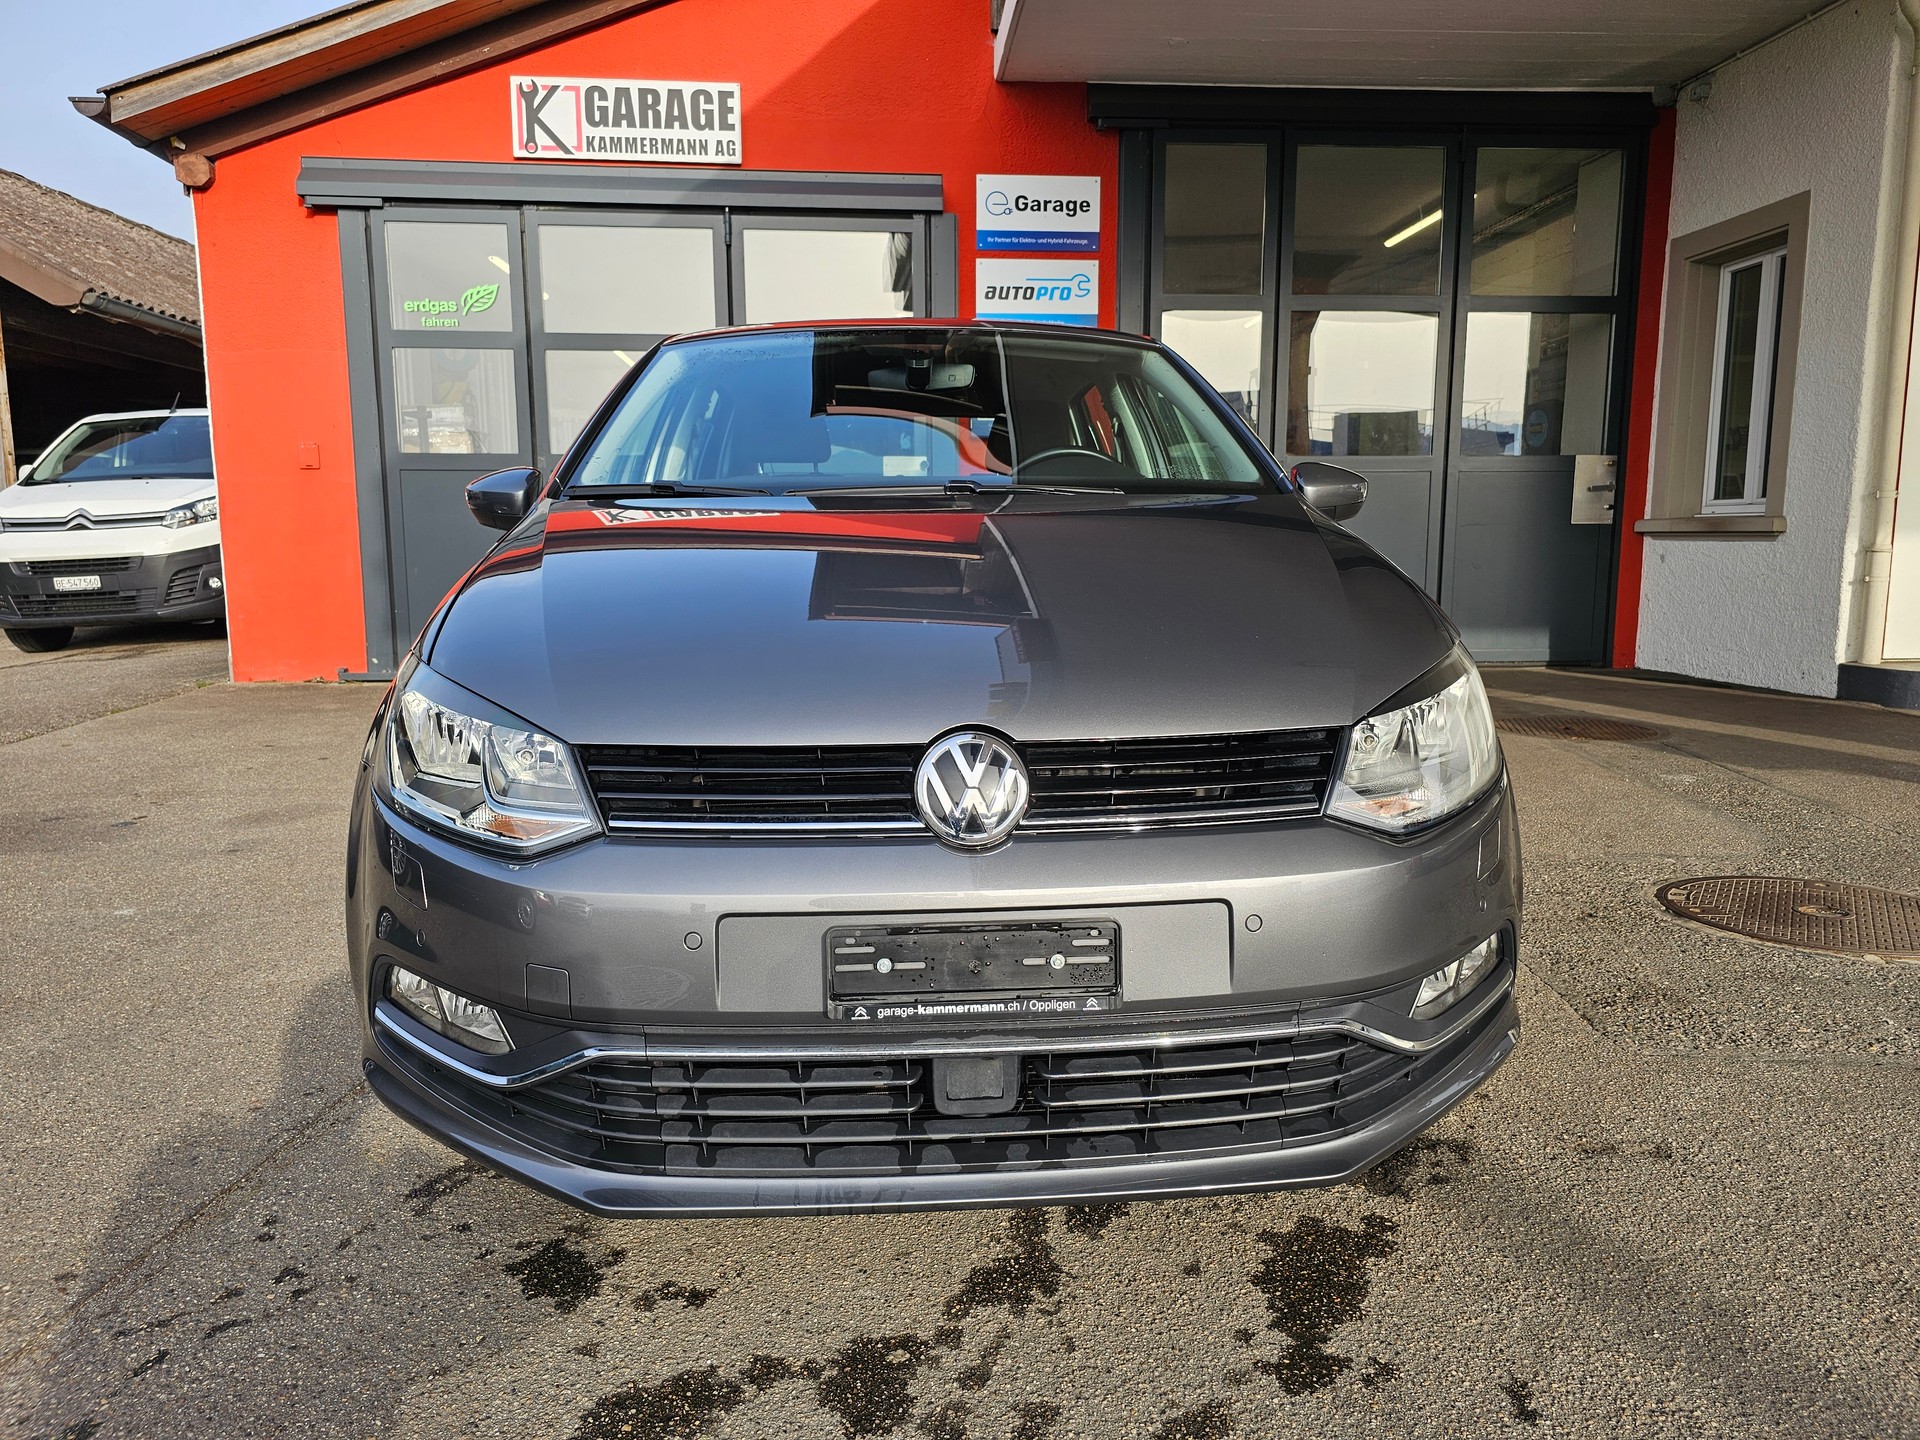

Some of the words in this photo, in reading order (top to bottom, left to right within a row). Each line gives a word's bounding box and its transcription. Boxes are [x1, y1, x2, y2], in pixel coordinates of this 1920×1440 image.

[584, 85, 736, 132] GARAGE
[586, 136, 709, 156] KAMMERMANN
[715, 139, 737, 157] AG
[403, 298, 458, 315] erdgas
[421, 316, 459, 327] fahren
[877, 1000, 1020, 1018] garage-kammermann.ch
[1029, 999, 1076, 1011] Oppligen
